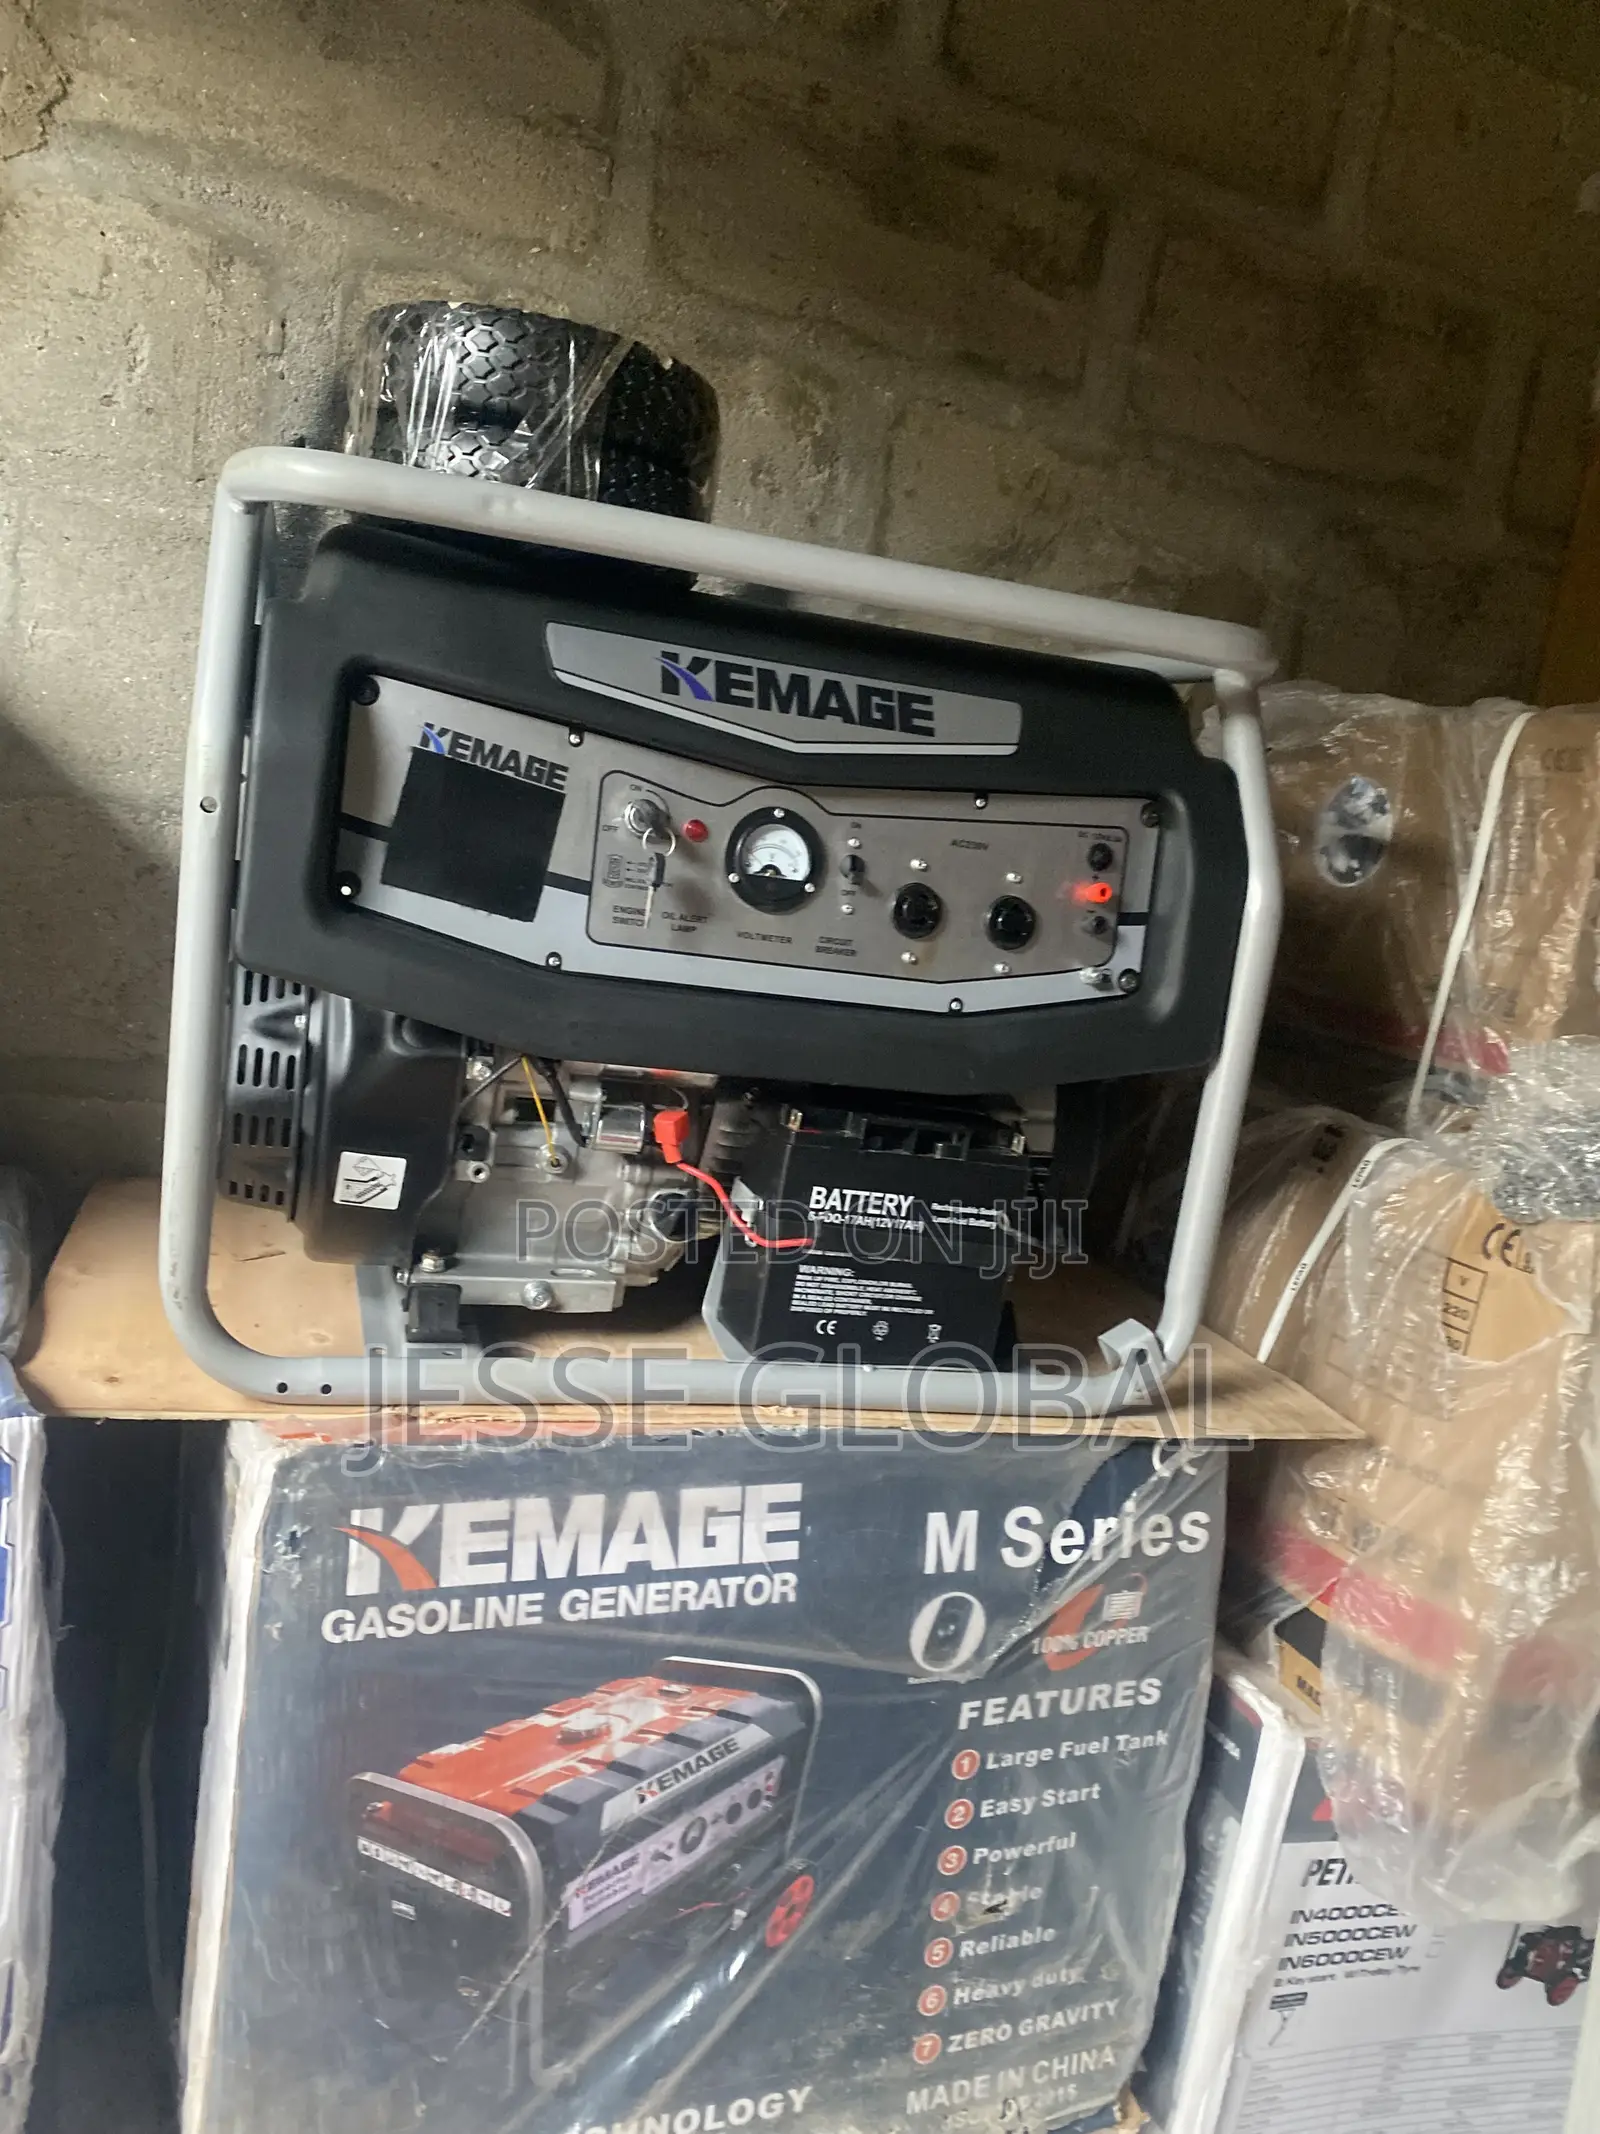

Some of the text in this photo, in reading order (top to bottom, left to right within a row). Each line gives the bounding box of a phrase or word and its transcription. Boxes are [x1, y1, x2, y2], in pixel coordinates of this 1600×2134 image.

[653, 650, 935, 737] KEMAGE
[420, 721, 570, 791] KEMAGE
[612, 904, 646, 916] ENGINE
[736, 930, 793, 945] VOLTMETER
[814, 945, 858, 957] BREAKER
[808, 1185, 916, 1218] BATTERY
[333, 1483, 803, 1597] KEMAGE
[923, 1504, 1213, 1575] M Series
[321, 1571, 800, 1645] GASOLINE GENERATOR
[1082, 1625, 1151, 1649] COPPER
[957, 1677, 1163, 1731] FEATURES
[985, 1746, 1055, 1771] Large
[1058, 1735, 1110, 1760] Fuel
[1115, 1728, 1171, 1752] Tank
[635, 1736, 741, 1805] KEMAGE
[979, 1796, 1036, 1819] Easy
[1040, 1782, 1102, 1808] Start
[972, 1831, 1078, 1866] Powerful
[959, 1926, 1057, 1959] Reliable
[1284, 1924, 1418, 1947] IN5000CEW
[1277, 1946, 1411, 1971] IN6000CEW
[947, 2023, 1013, 2054] ZERO
[1018, 1998, 1121, 2037] GRAVITY
[906, 2073, 992, 2116] MADE
[997, 2065, 1026, 2092] IN
[1032, 2045, 1117, 2084] CHINA
